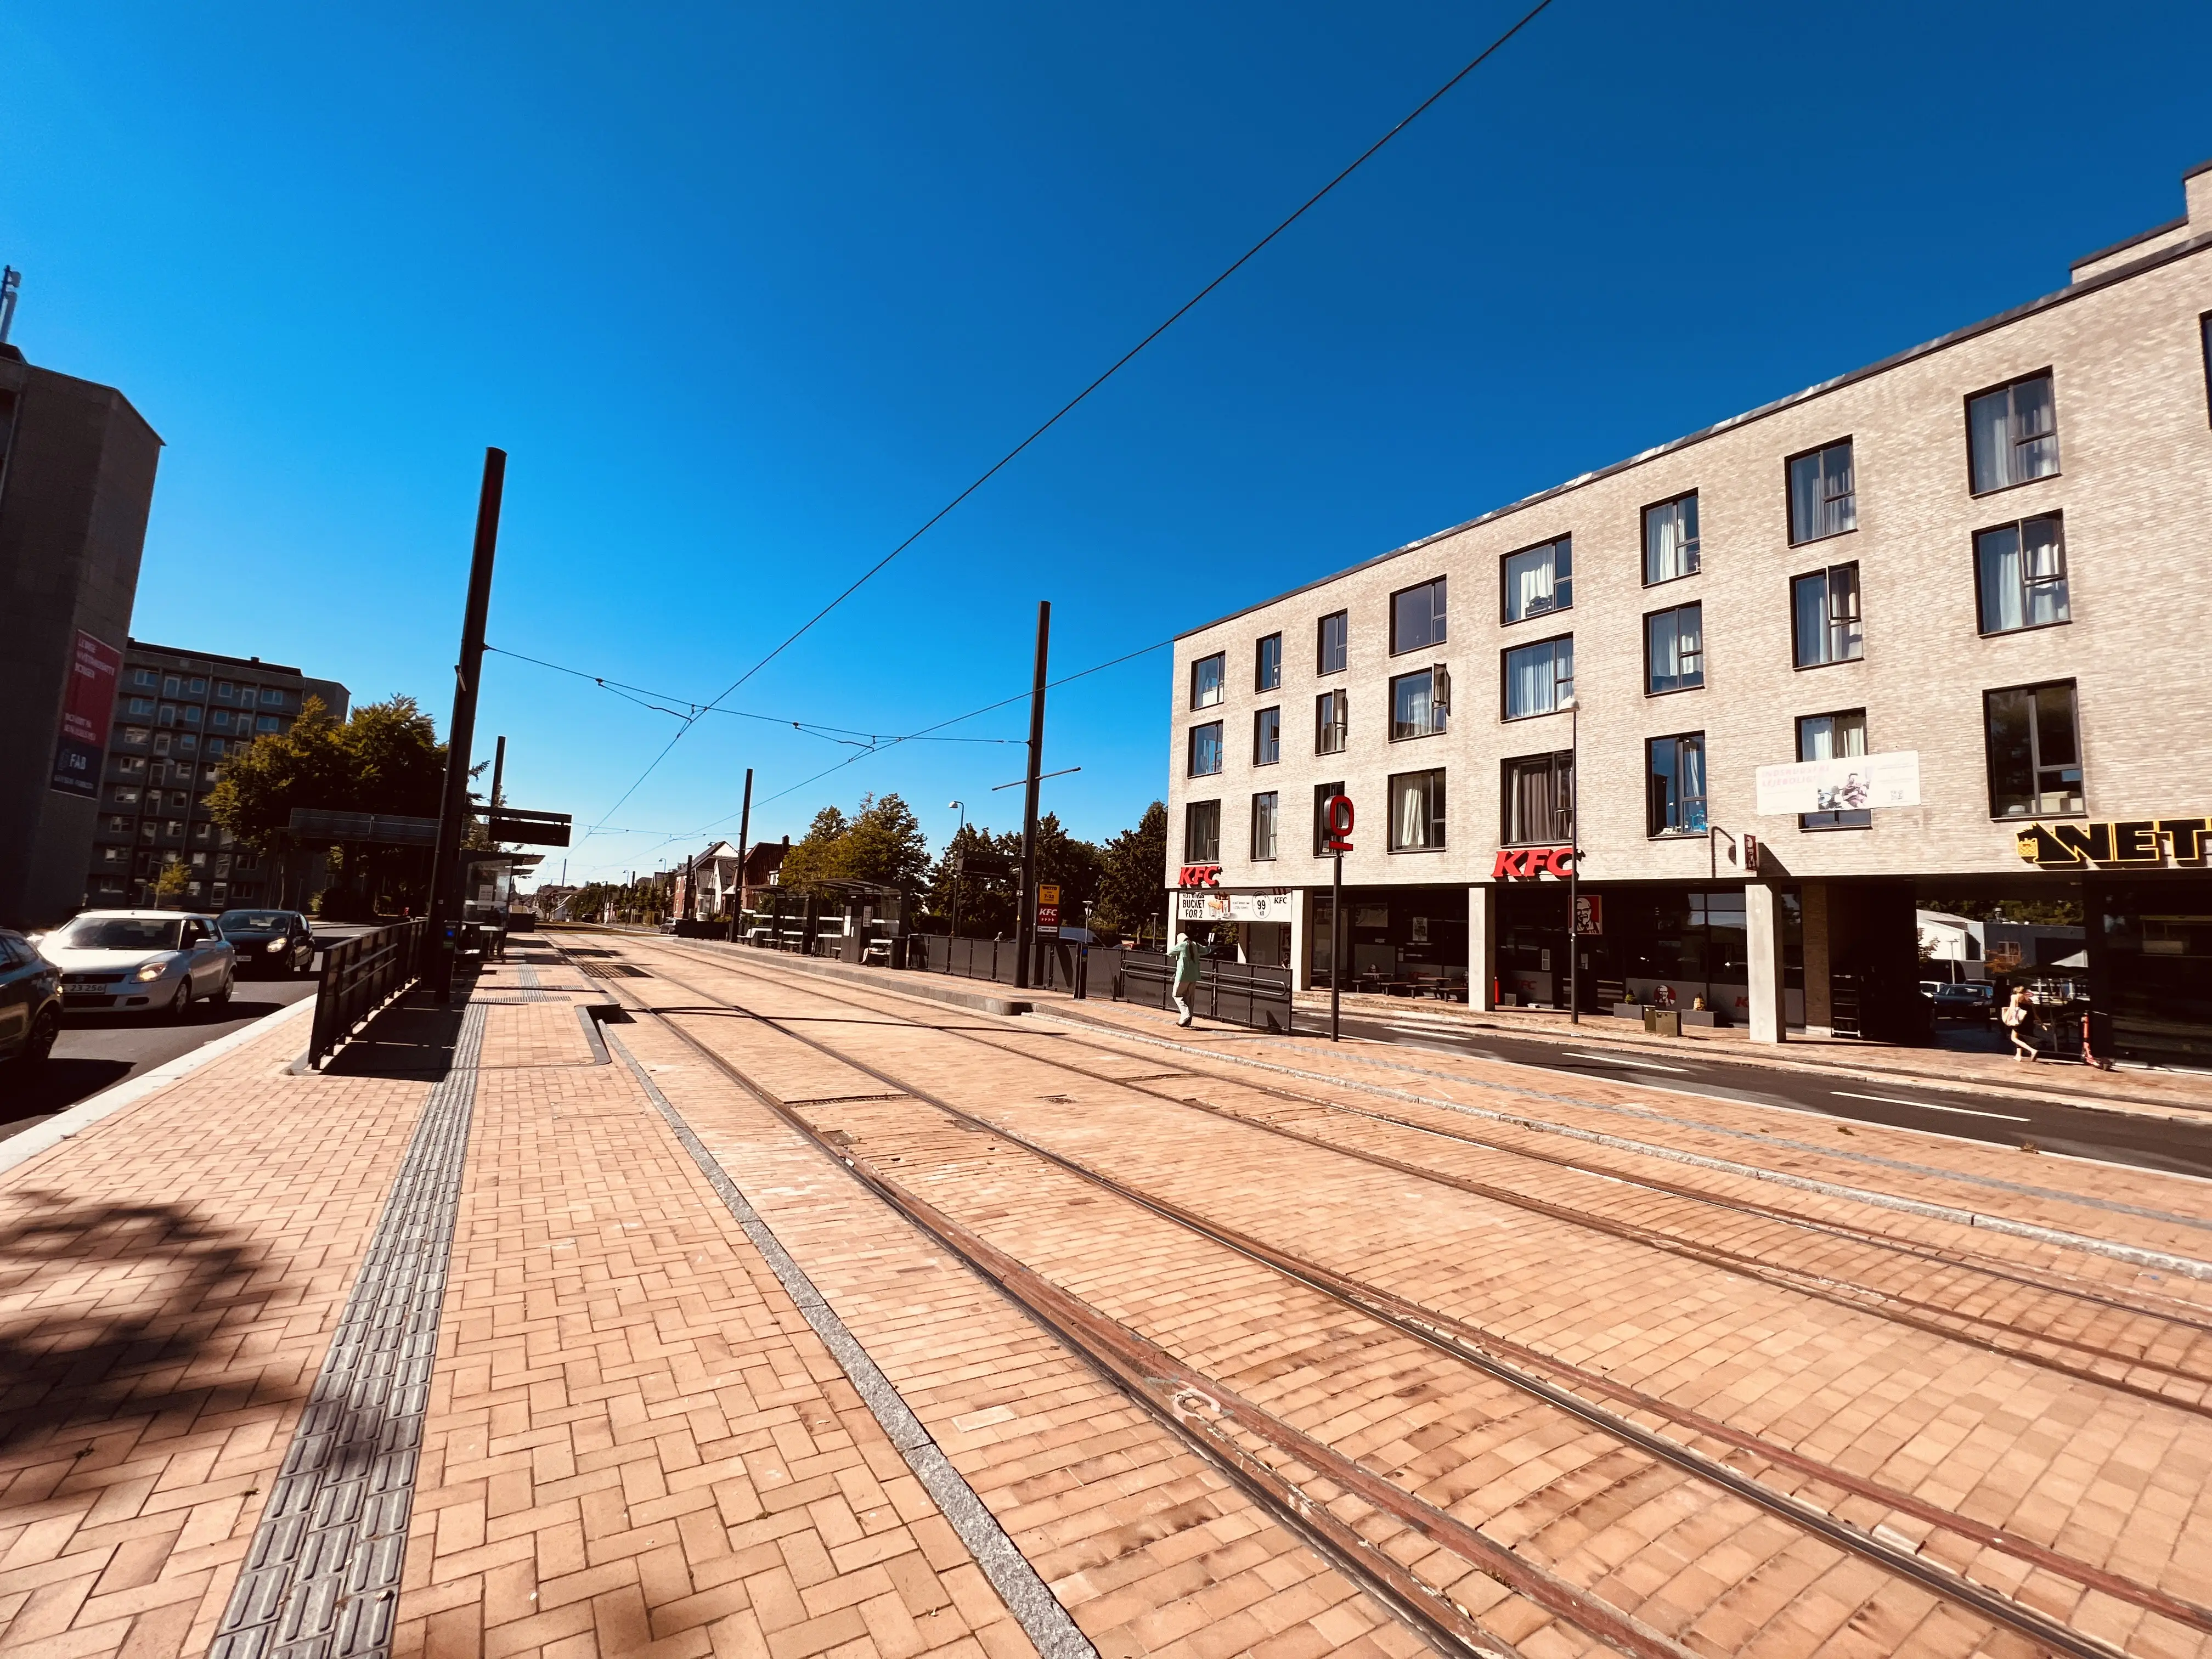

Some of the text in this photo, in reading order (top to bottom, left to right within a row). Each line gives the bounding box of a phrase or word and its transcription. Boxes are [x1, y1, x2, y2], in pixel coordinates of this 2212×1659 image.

[69, 754, 87, 770] FAB
[2016, 817, 2212, 863] NET
[1491, 848, 1576, 877] KFC
[1178, 866, 1218, 885] KFC
[1182, 899, 1205, 909] BUCKET
[1257, 900, 1266, 910] 99
[1039, 908, 1058, 916] KFC
[1185, 909, 1203, 918] FOR 2
